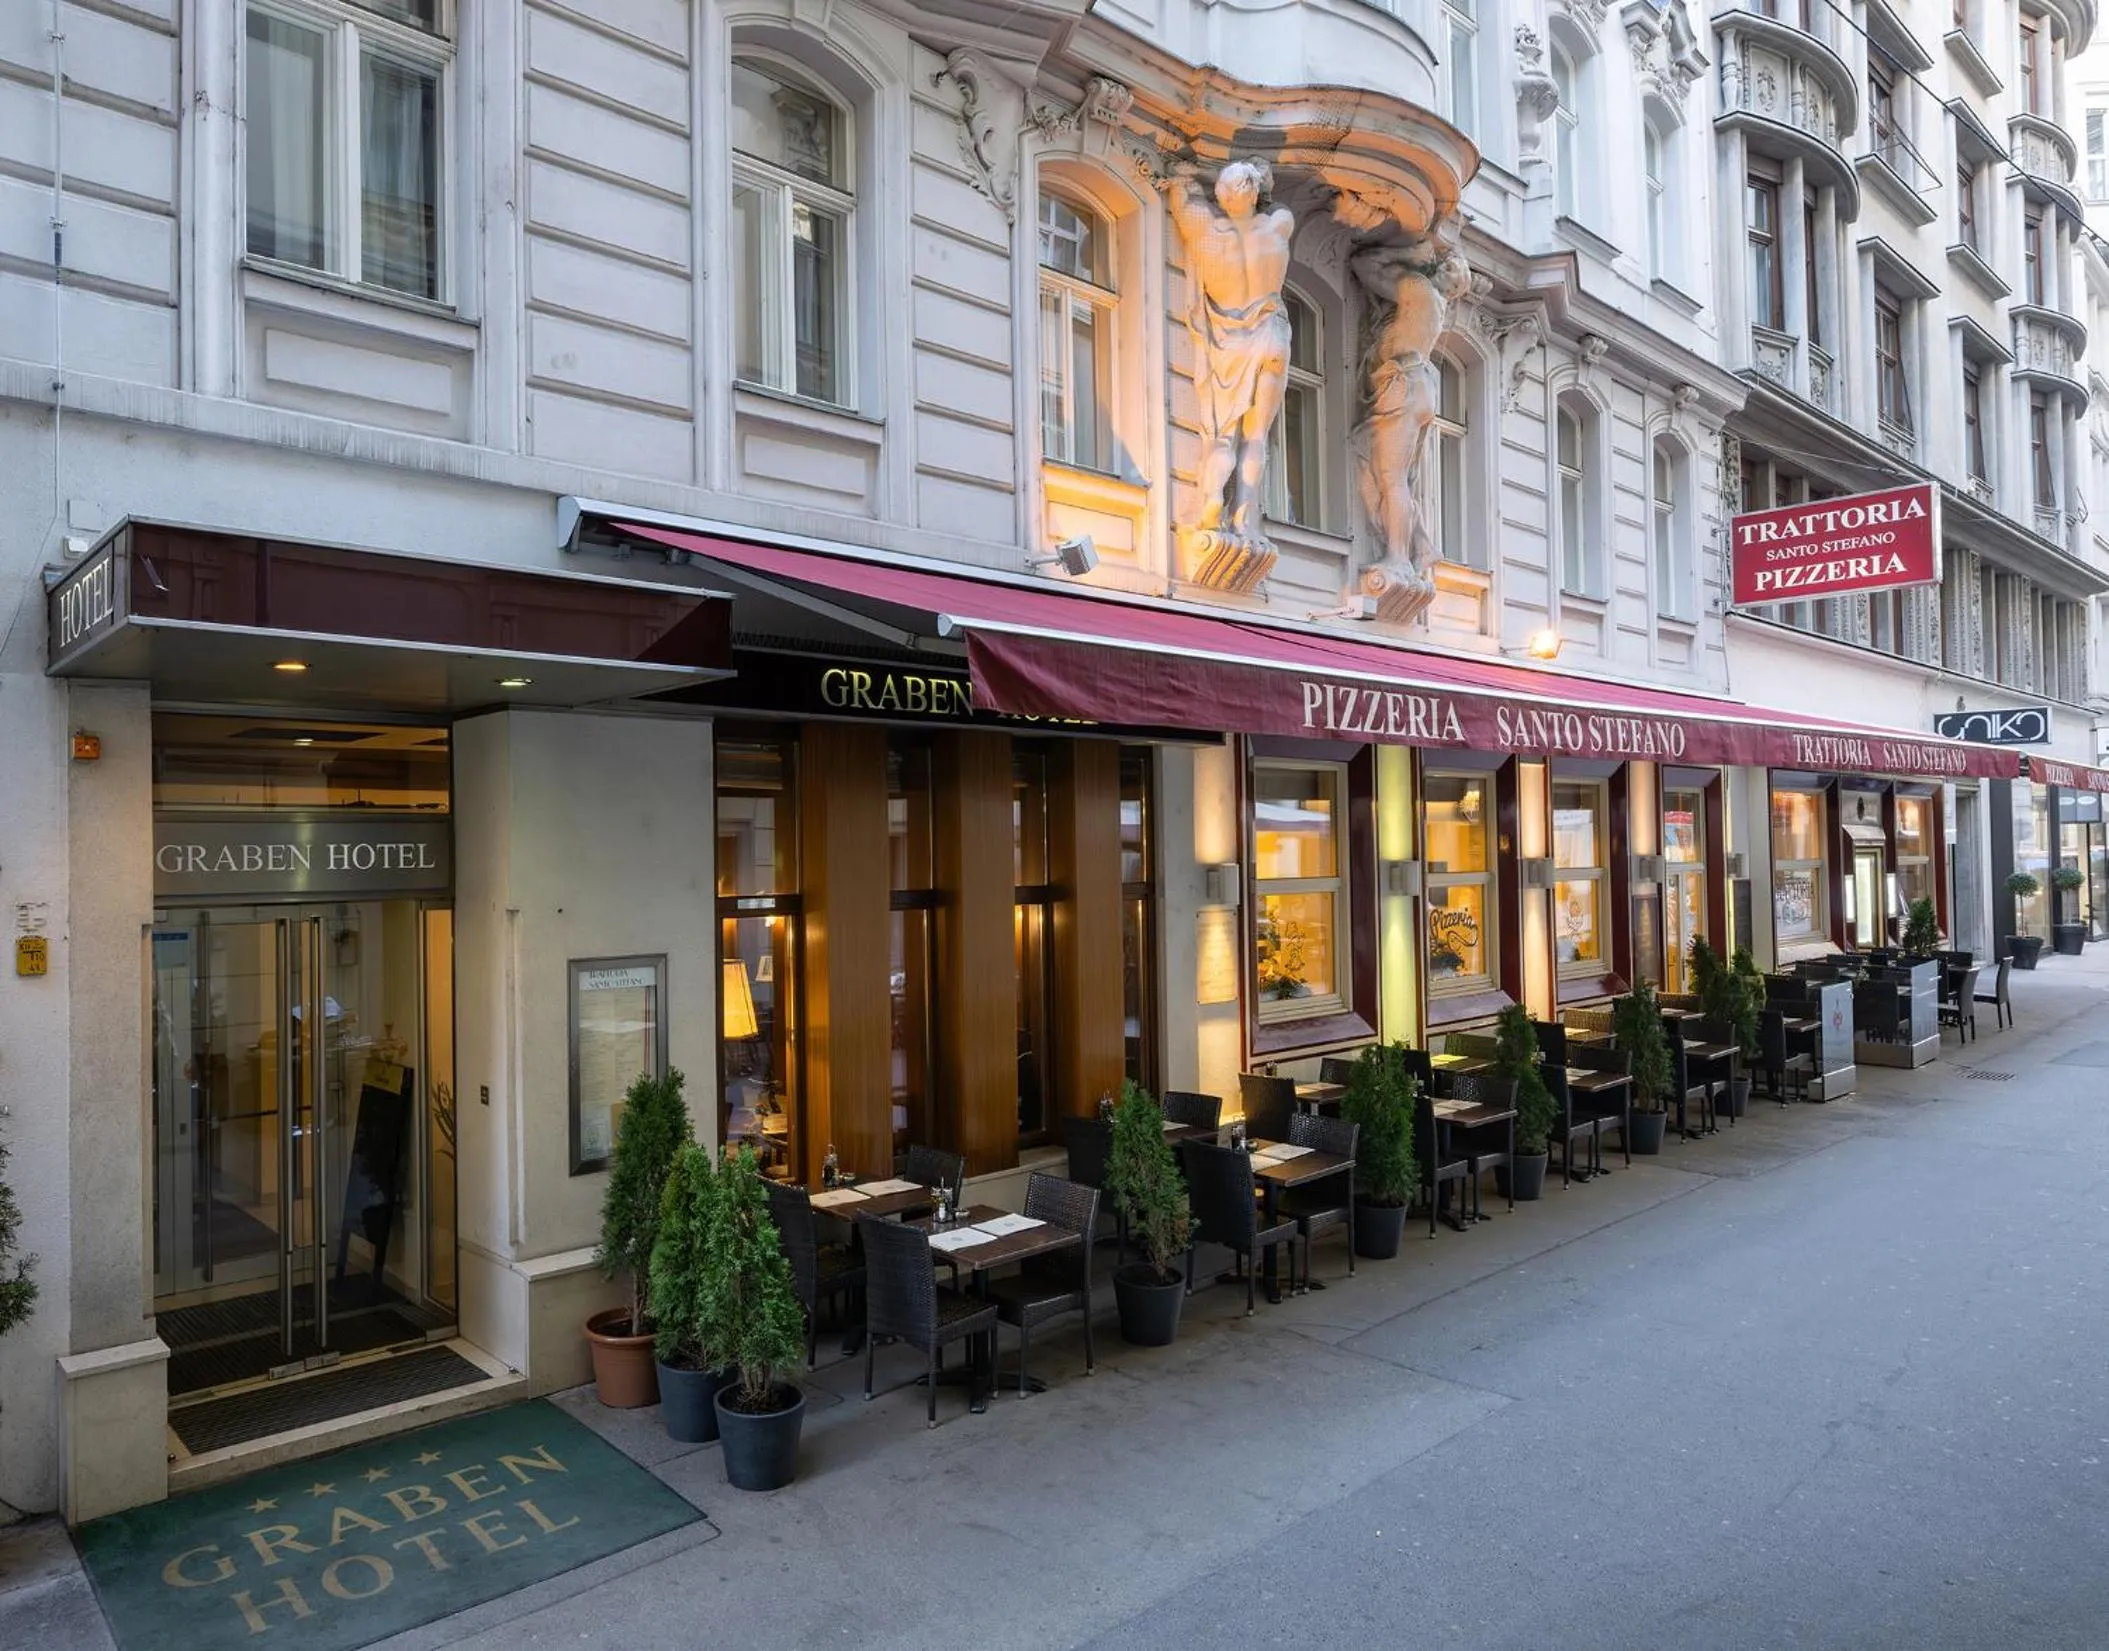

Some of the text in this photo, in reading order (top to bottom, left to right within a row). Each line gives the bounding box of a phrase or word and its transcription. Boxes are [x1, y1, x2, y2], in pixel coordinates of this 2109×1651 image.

[1739, 497, 1926, 545] TRATTORIA
[1766, 531, 1895, 561] SANTO STEFANO
[1754, 552, 1908, 592] PIZZERIA
[60, 557, 113, 648] HOTEL
[820, 668, 974, 717] GRABEN
[1301, 682, 1685, 758] PIZZERIA SANTO STEFANO
[1792, 734, 1967, 772] TRATTORIA SANTO STEFANO
[156, 843, 436, 873] GRABEN HOTEL
[161, 1444, 569, 1588] GRABEN
[228, 1499, 580, 1636] HOTEL
